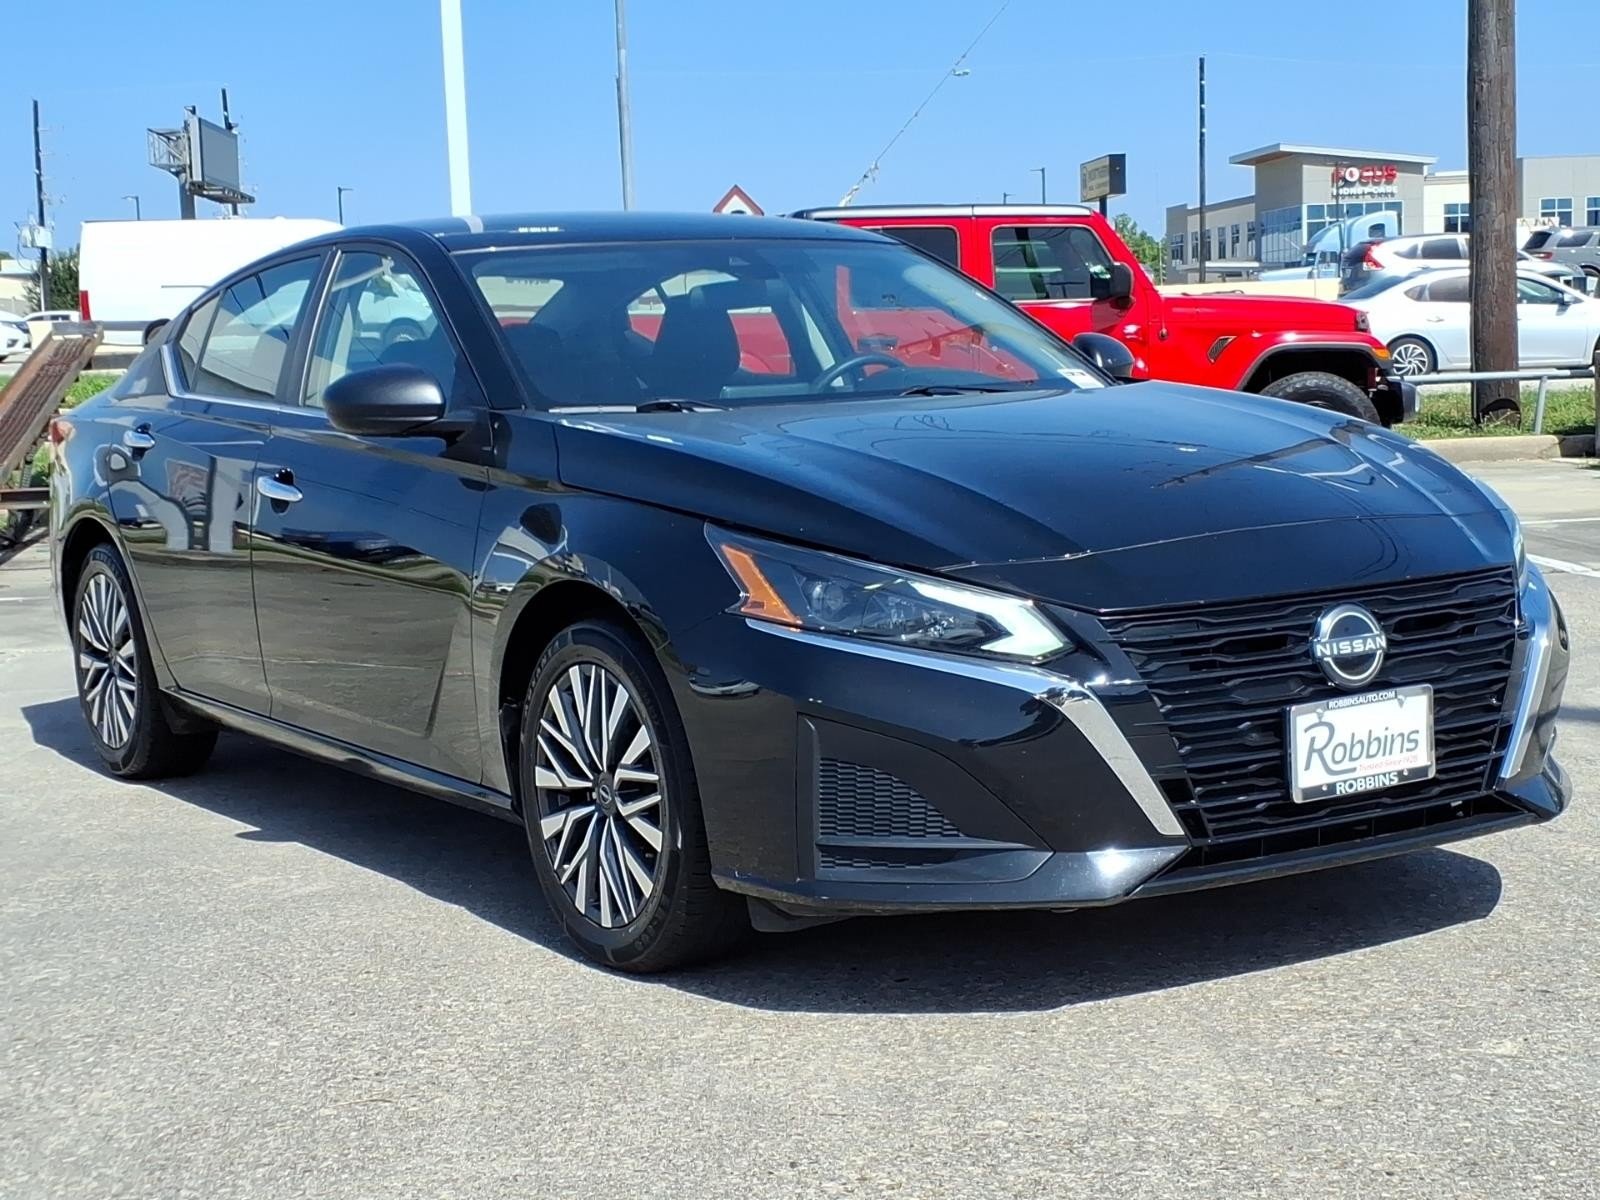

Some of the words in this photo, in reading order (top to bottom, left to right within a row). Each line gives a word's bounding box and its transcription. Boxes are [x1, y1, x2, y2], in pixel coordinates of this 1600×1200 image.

[1316, 635, 1387, 657] NISSAN
[1328, 690, 1396, 710] ROBBINSAUTO.COM
[1303, 720, 1420, 776] Robbins
[1335, 771, 1400, 796] ROBBINS
